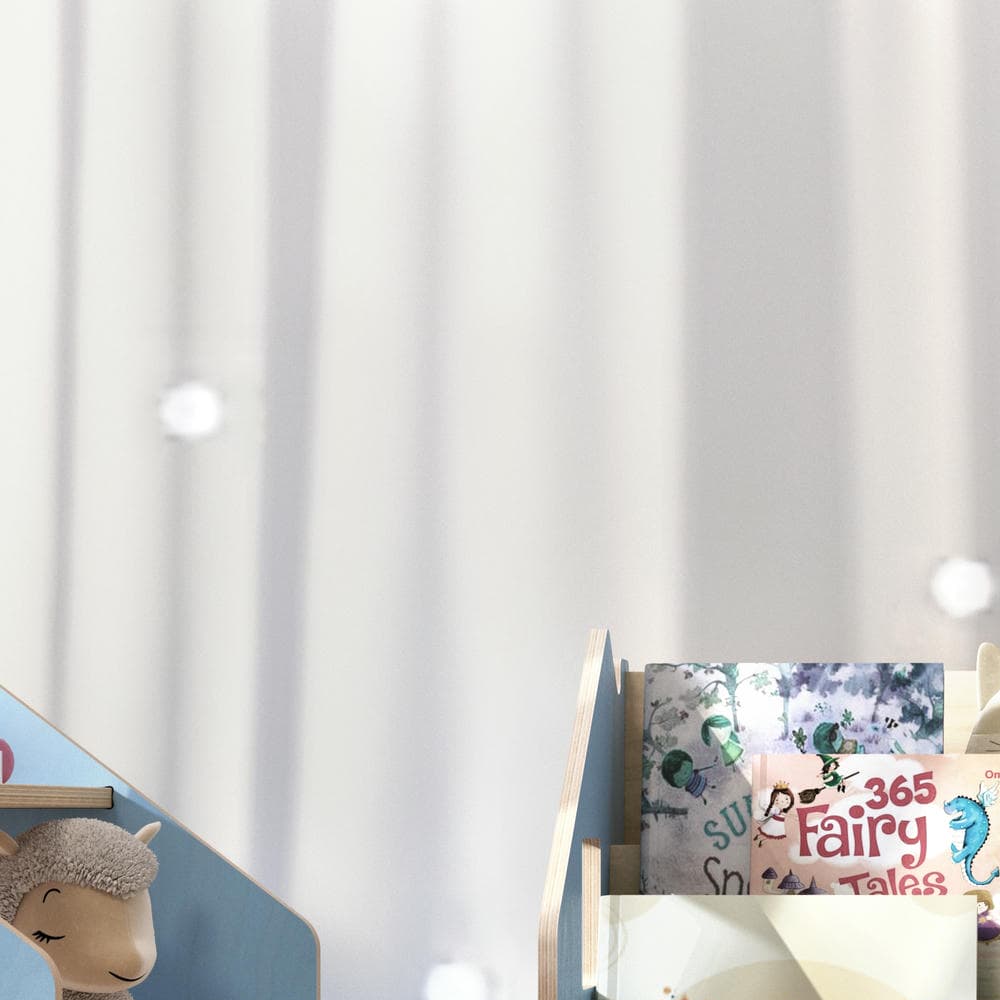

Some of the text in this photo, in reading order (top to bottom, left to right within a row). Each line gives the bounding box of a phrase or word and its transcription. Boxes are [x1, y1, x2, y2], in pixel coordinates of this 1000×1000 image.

[864, 771, 937, 810] 365
[796, 804, 928, 869] Fairy
[703, 856, 750, 895] Sn
